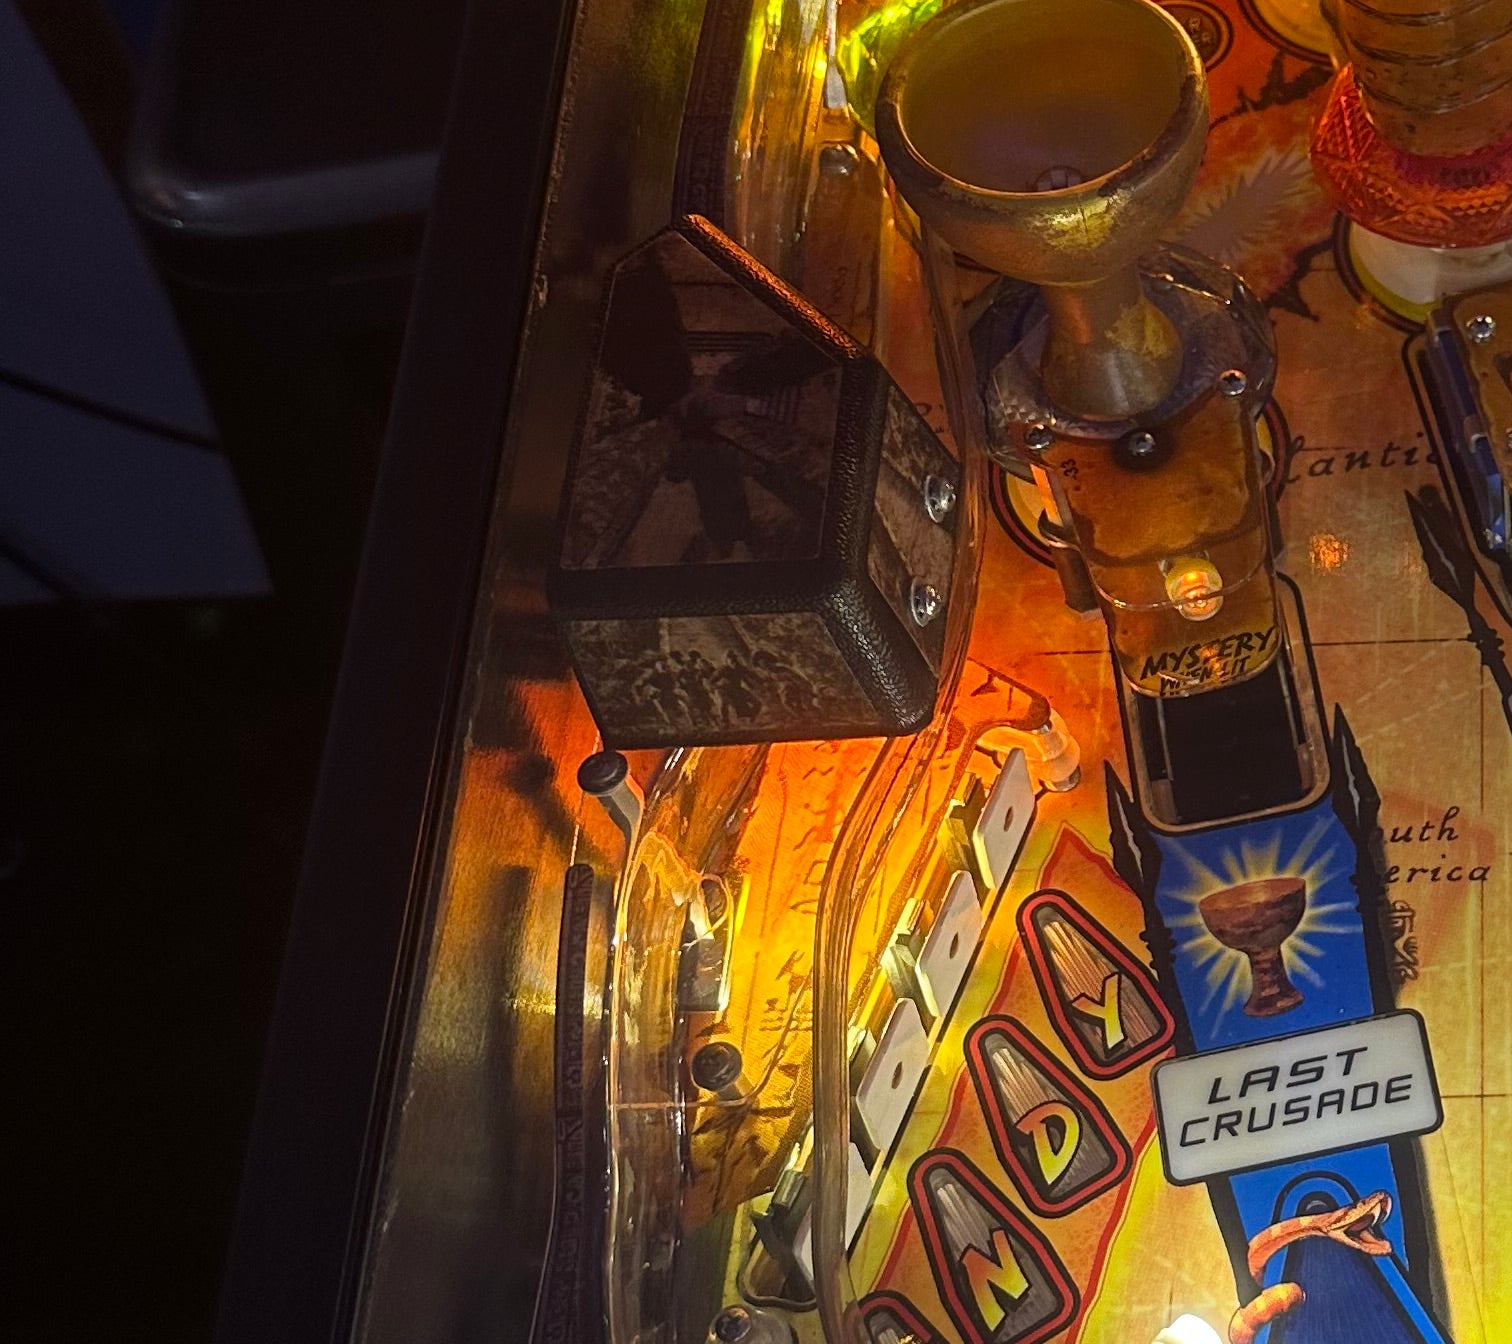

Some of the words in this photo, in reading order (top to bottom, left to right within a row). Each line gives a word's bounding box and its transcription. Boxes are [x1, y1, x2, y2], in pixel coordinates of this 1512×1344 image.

[1140, 623, 1279, 681] MYSTERY
[1207, 1045, 1370, 1107] LAST
[1178, 1073, 1414, 1149] CRUSADE
[960, 1229, 1031, 1334] N
[1016, 1099, 1082, 1187] D
[1072, 973, 1126, 1050] Y
